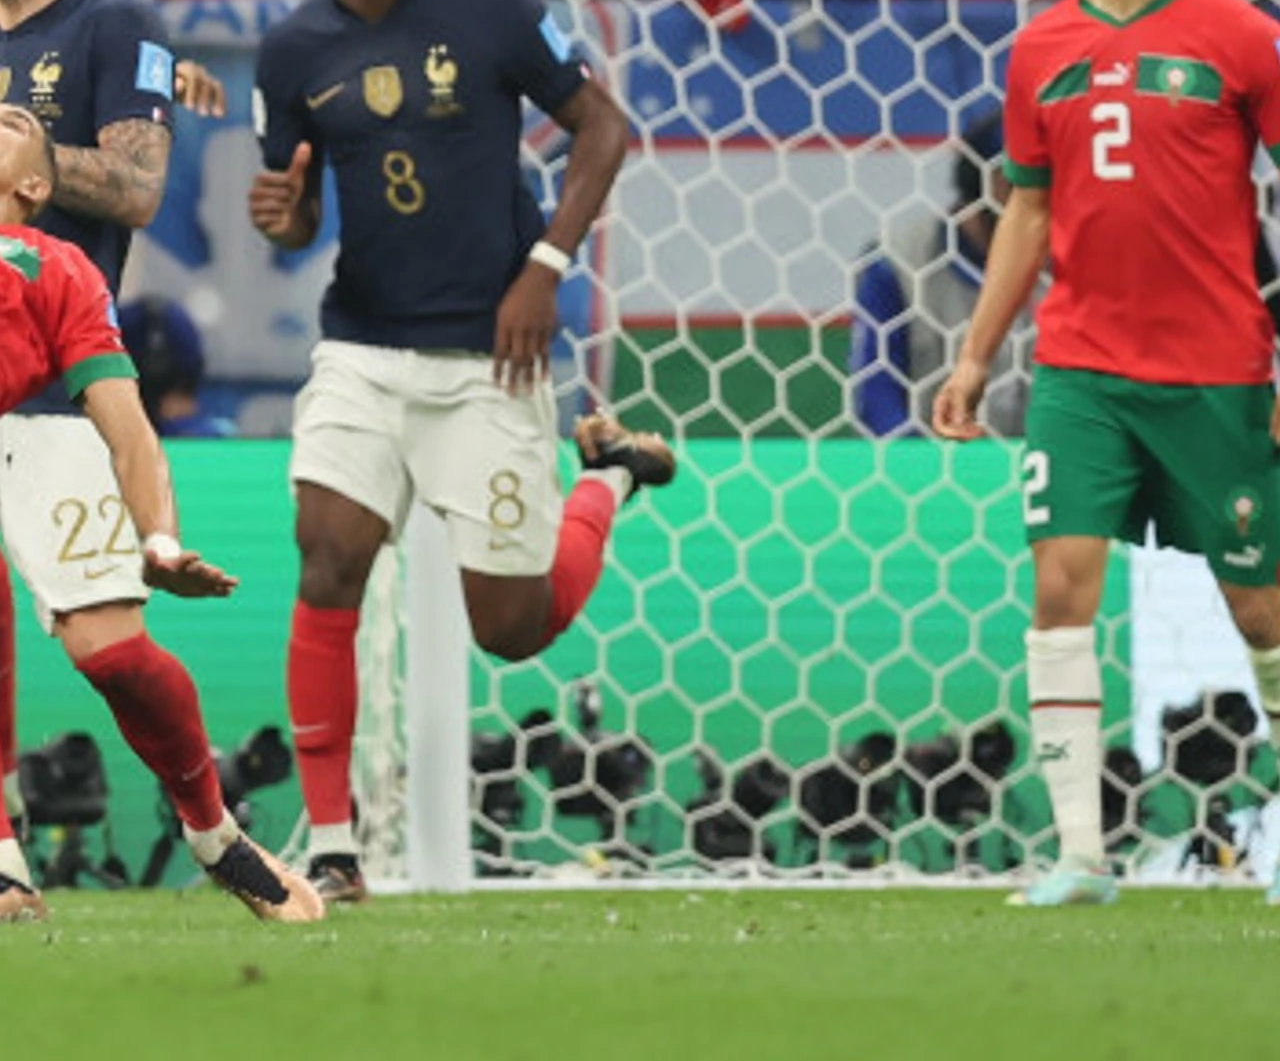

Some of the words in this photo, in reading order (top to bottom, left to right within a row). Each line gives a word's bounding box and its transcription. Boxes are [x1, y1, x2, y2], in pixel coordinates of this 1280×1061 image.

[1091, 102, 1134, 179] 2
[384, 150, 425, 214] 8
[488, 469, 526, 530] 8
[1023, 451, 1050, 525] 2
[51, 495, 136, 564] 22
